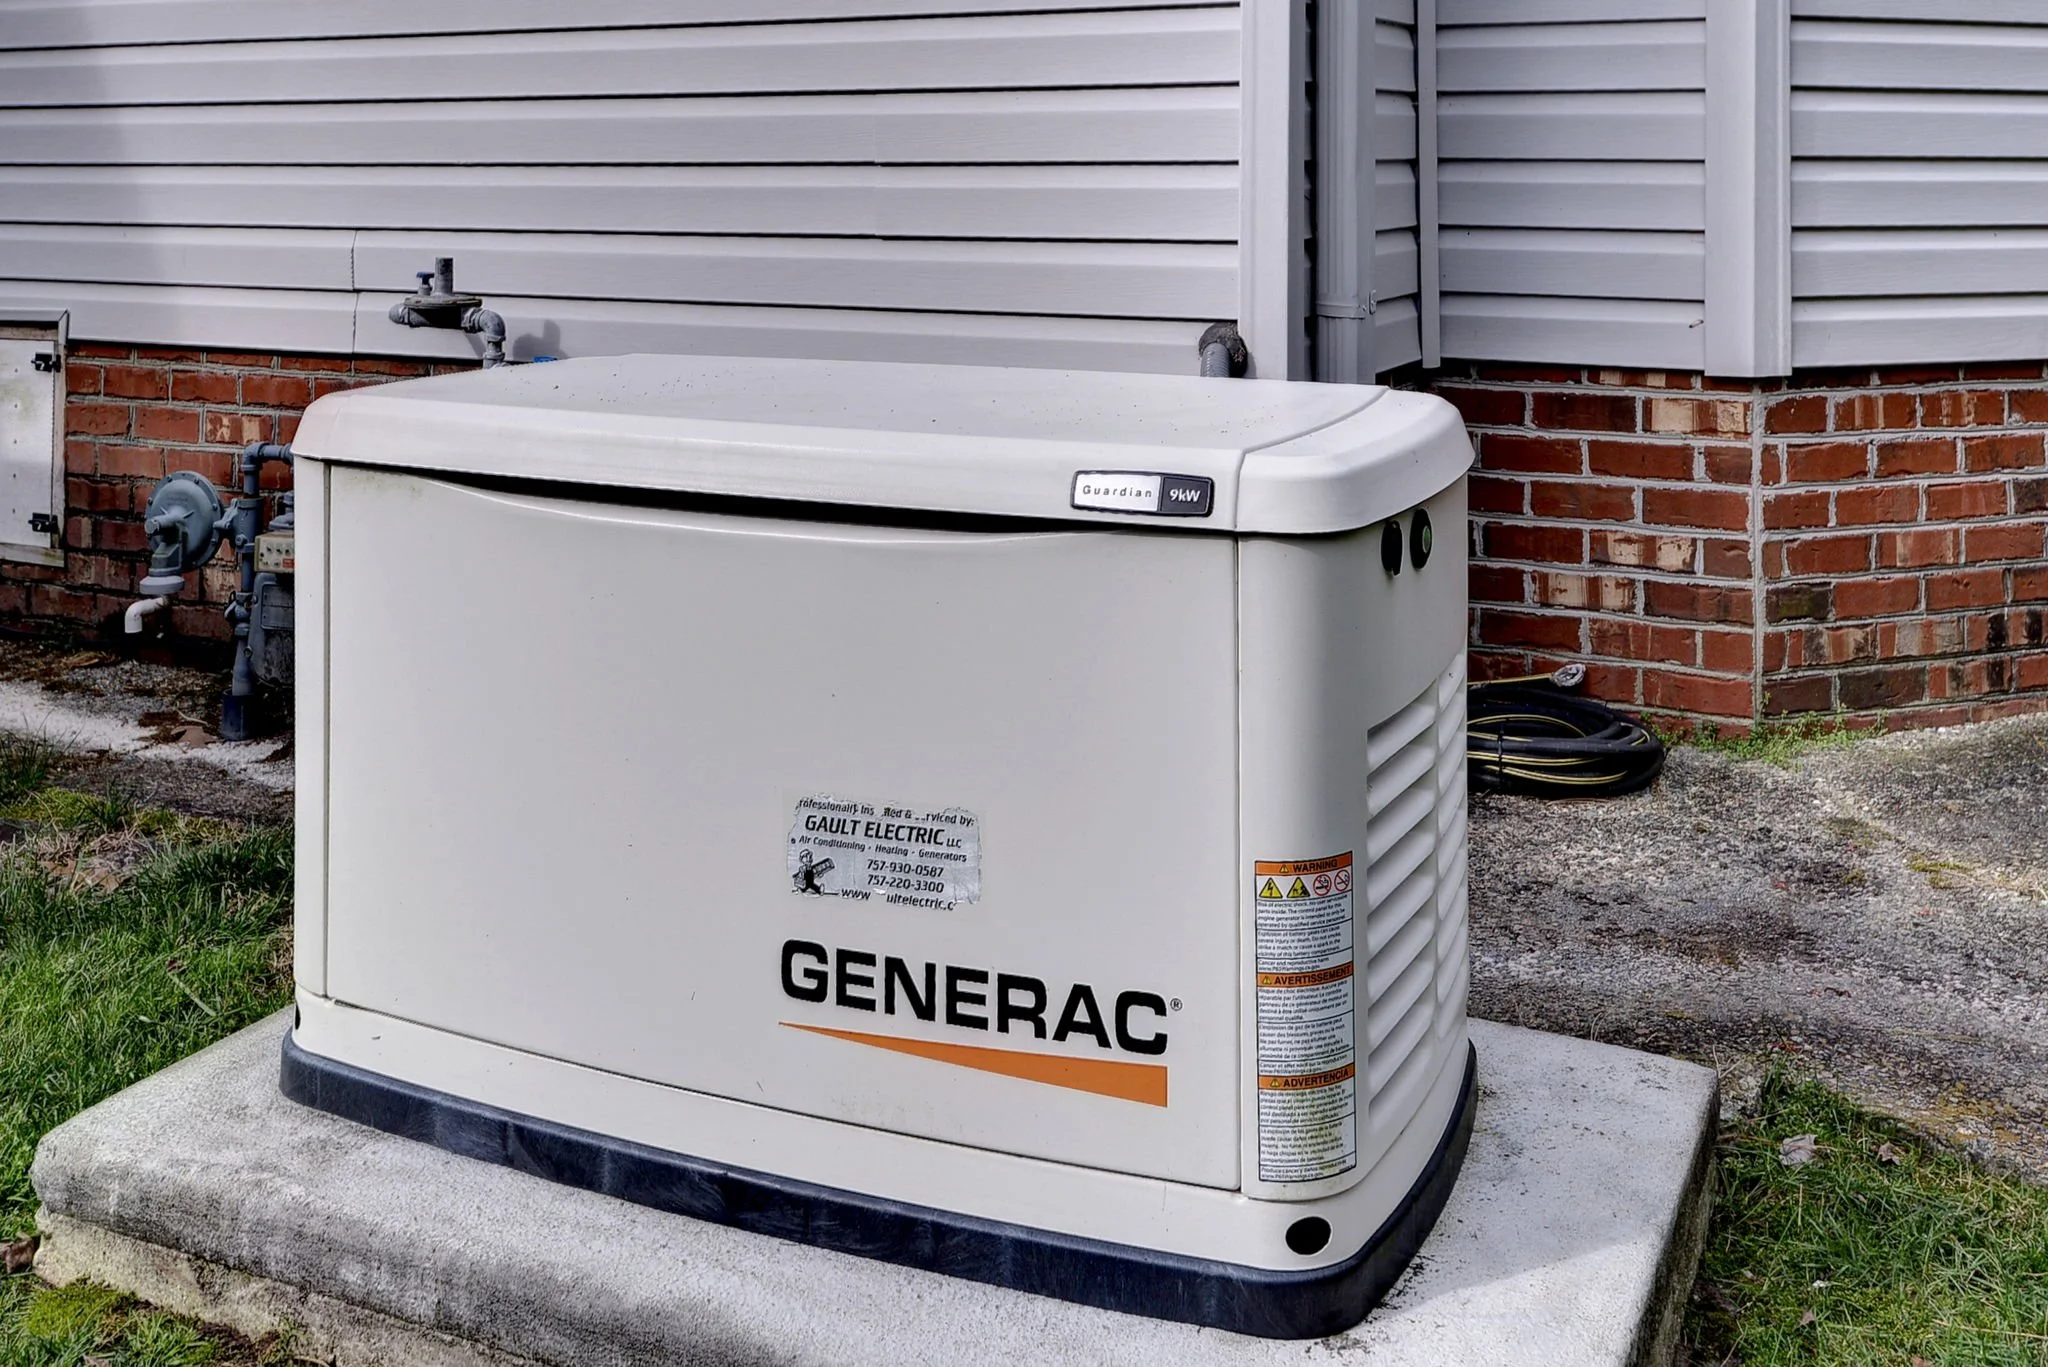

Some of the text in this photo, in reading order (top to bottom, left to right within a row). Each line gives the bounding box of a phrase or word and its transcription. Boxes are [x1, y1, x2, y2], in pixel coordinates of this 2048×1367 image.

[1082, 485, 1201, 502] Guardian 9kW
[796, 799, 859, 815] rofessionally
[904, 809, 912, 819] &
[959, 814, 974, 827] by:
[805, 814, 962, 848] GAULT ELECTRIC LLC
[798, 835, 967, 862] Air Conditioning Heating Generators
[867, 858, 944, 878] 757-930-0587
[1292, 859, 1338, 873] WARNING
[867, 874, 945, 893] 757-220-3300
[1274, 965, 1351, 984] AVERTISSEMENT
[1283, 1068, 1349, 1087] ADVERTENCIA
